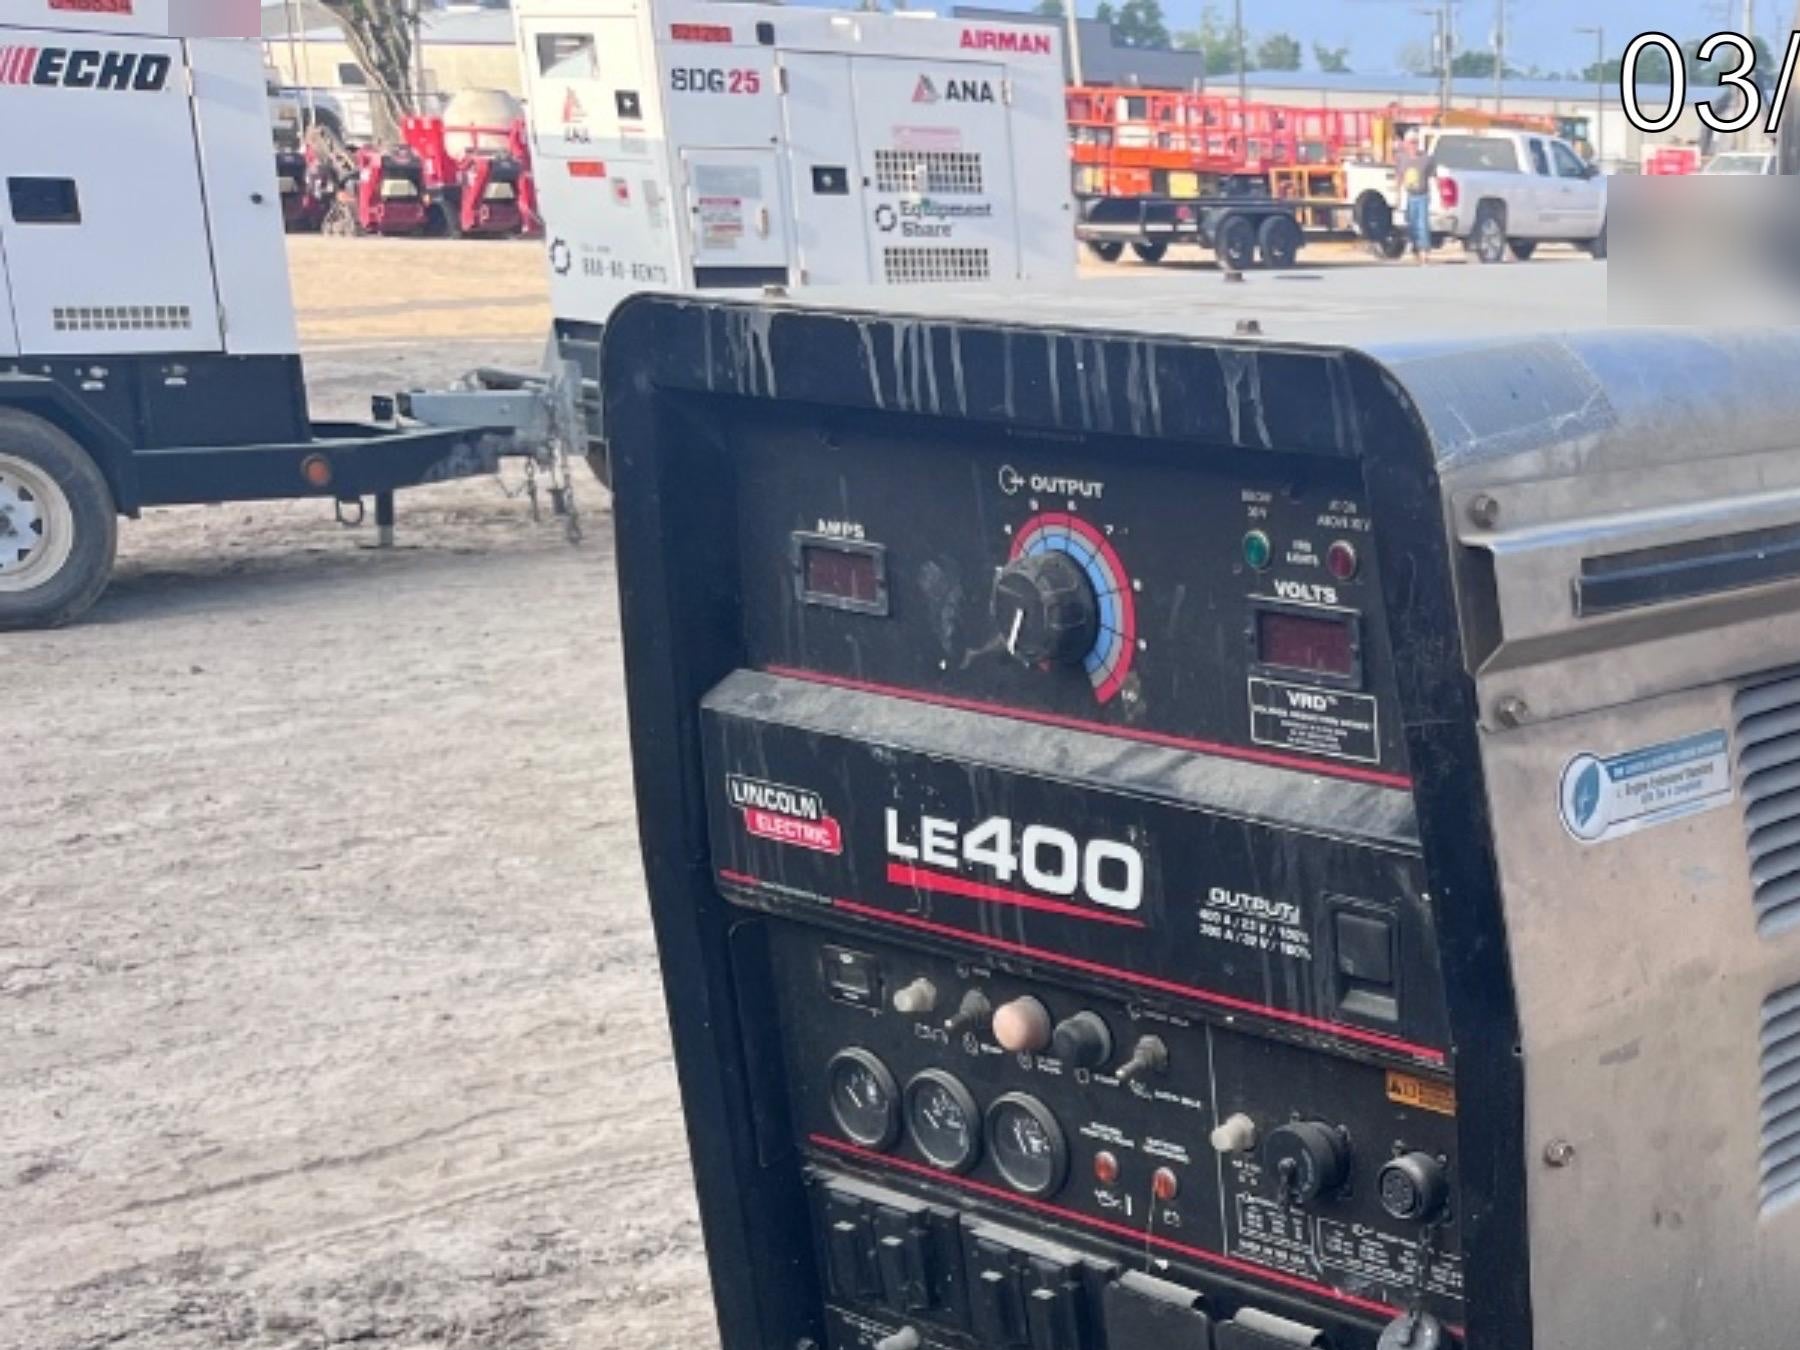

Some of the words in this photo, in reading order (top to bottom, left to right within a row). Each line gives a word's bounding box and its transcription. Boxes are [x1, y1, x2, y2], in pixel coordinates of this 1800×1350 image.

[959, 29, 1051, 54] AIRMAN
[33, 47, 171, 91] ECHO
[728, 68, 761, 94] 25
[945, 79, 995, 102] ANA
[1029, 474, 1104, 499] OUTPUT
[818, 518, 865, 539] AMPS
[1273, 578, 1338, 605] VOLTS
[731, 779, 819, 820] LINCOLN
[754, 811, 832, 847] ELECTRIC
[884, 806, 1144, 911] LE400
